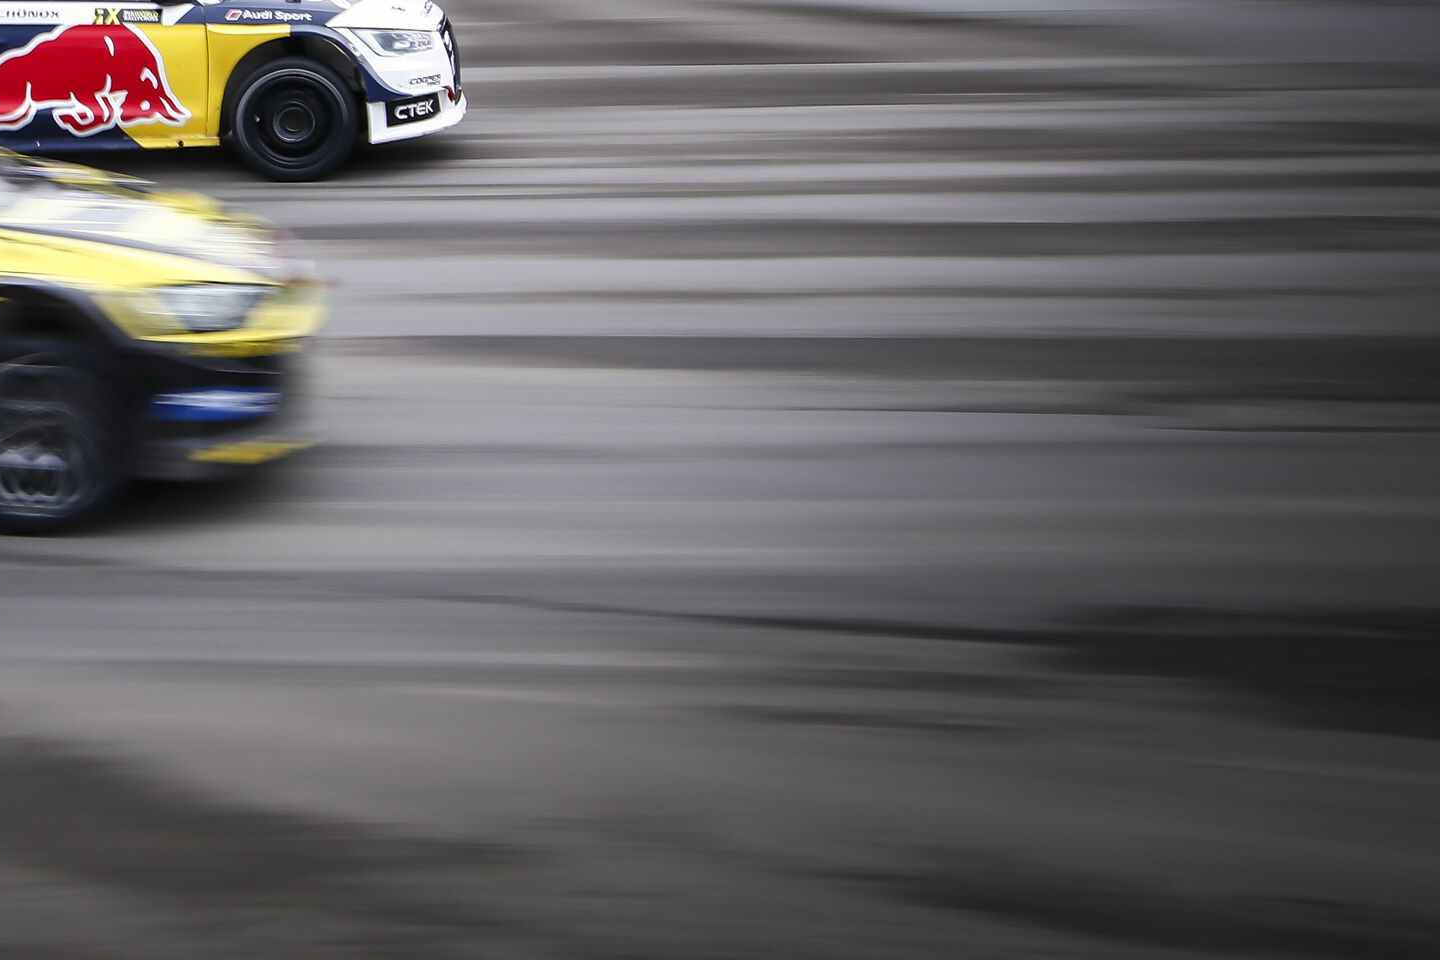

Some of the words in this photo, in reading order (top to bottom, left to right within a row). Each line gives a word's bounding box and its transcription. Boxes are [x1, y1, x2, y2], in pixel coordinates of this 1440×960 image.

[242, 9, 273, 21] Audi
[274, 10, 313, 22] Sport
[394, 99, 435, 120] CTEK
